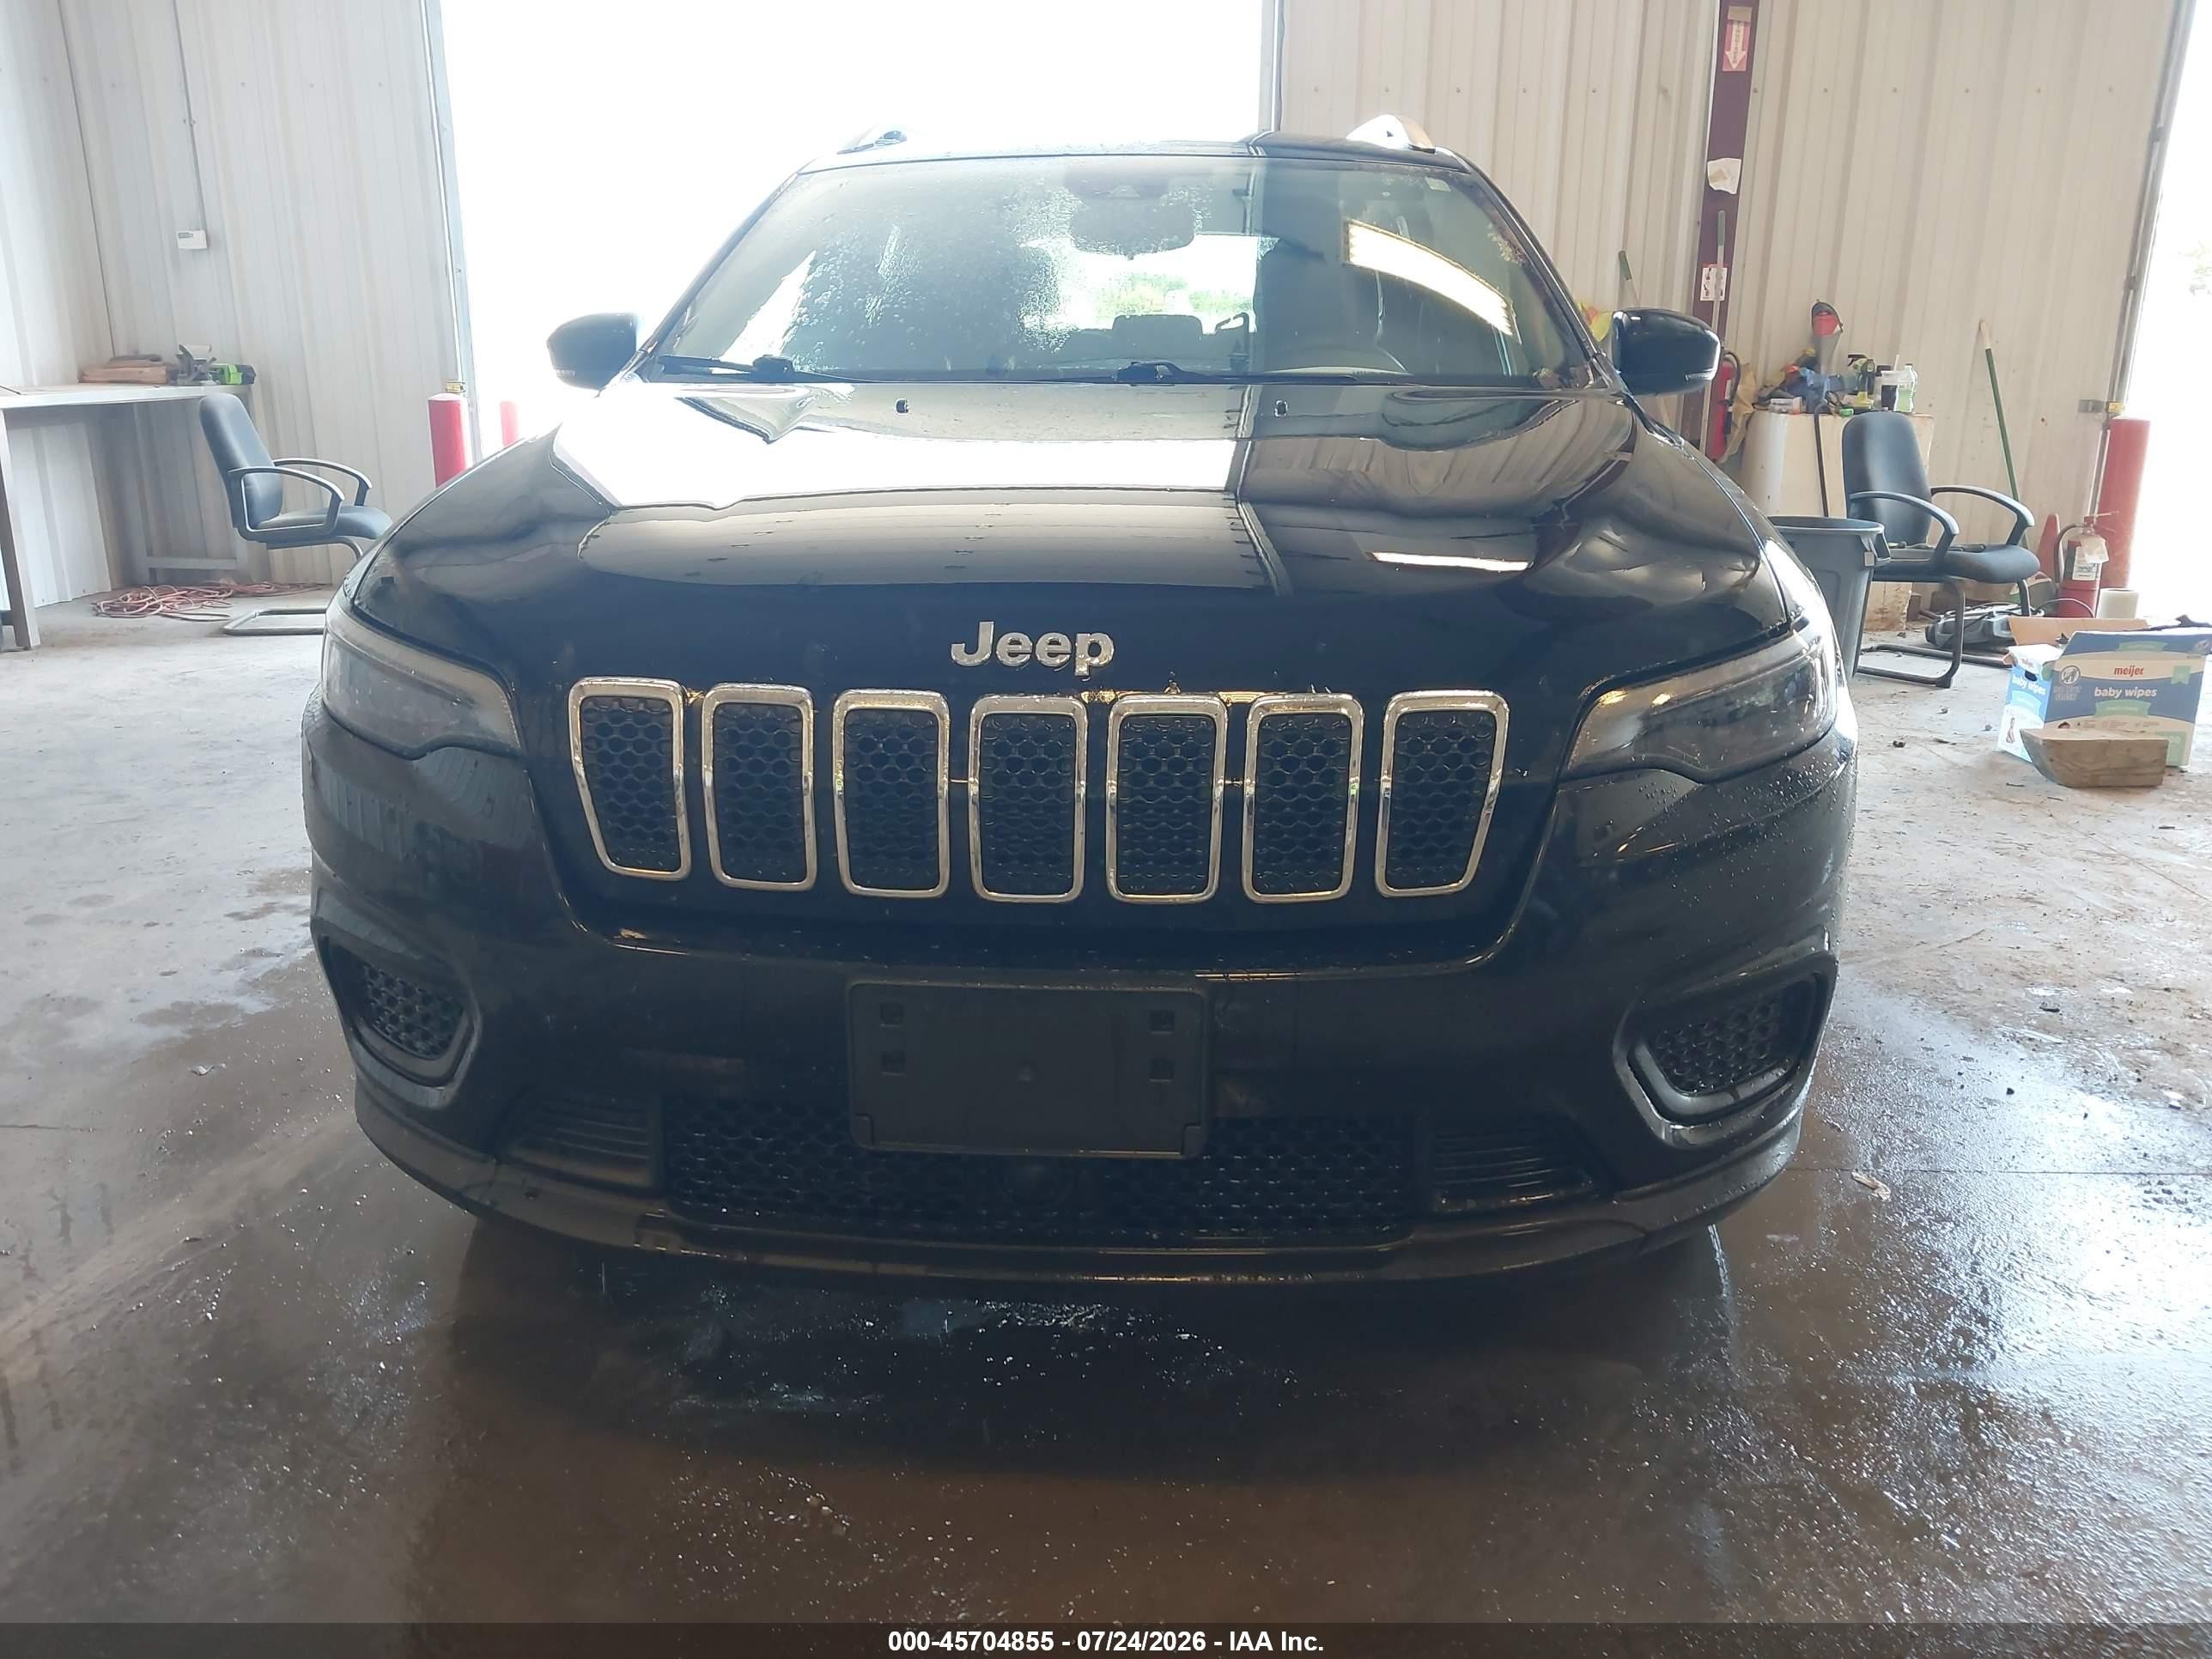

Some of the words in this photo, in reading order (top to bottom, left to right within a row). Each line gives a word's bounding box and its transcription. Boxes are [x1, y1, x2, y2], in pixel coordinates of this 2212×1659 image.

[951, 621, 1115, 676] Jeep
[2113, 665, 2145, 677] meijer
[2094, 687, 2123, 699] baby
[2124, 687, 2158, 699] wipes
